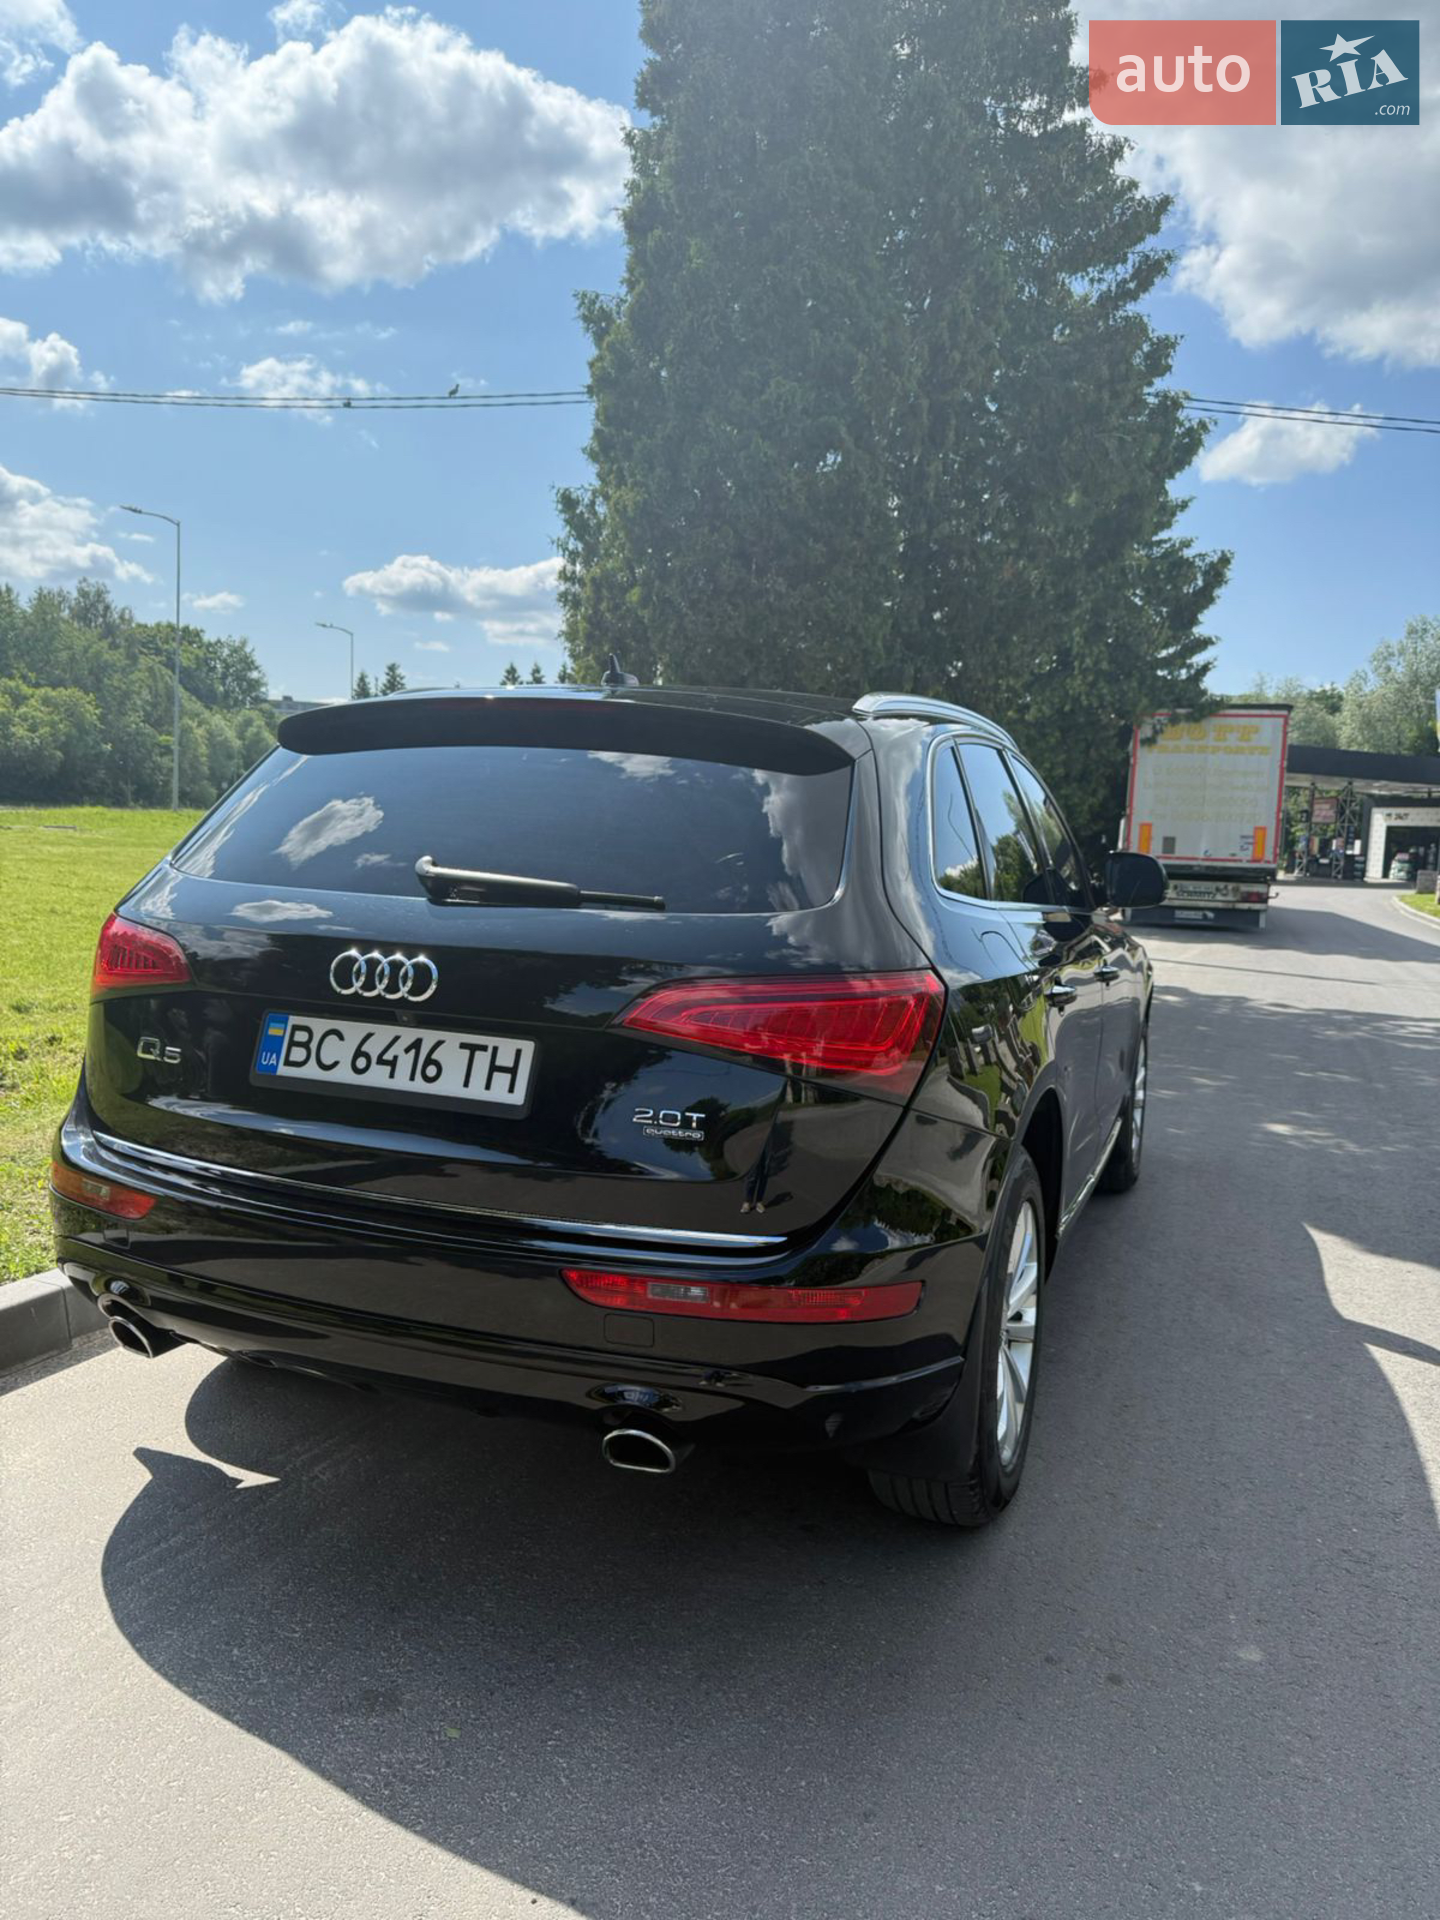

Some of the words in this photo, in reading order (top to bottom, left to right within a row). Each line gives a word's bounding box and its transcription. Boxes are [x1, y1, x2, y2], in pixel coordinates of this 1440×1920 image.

[136, 1036, 182, 1064] Q5
[261, 1051, 277, 1066] UA
[282, 1023, 345, 1072] BC
[350, 1031, 446, 1084] 6416
[459, 1042, 522, 1094] TH
[645, 1127, 702, 1139] quattro
